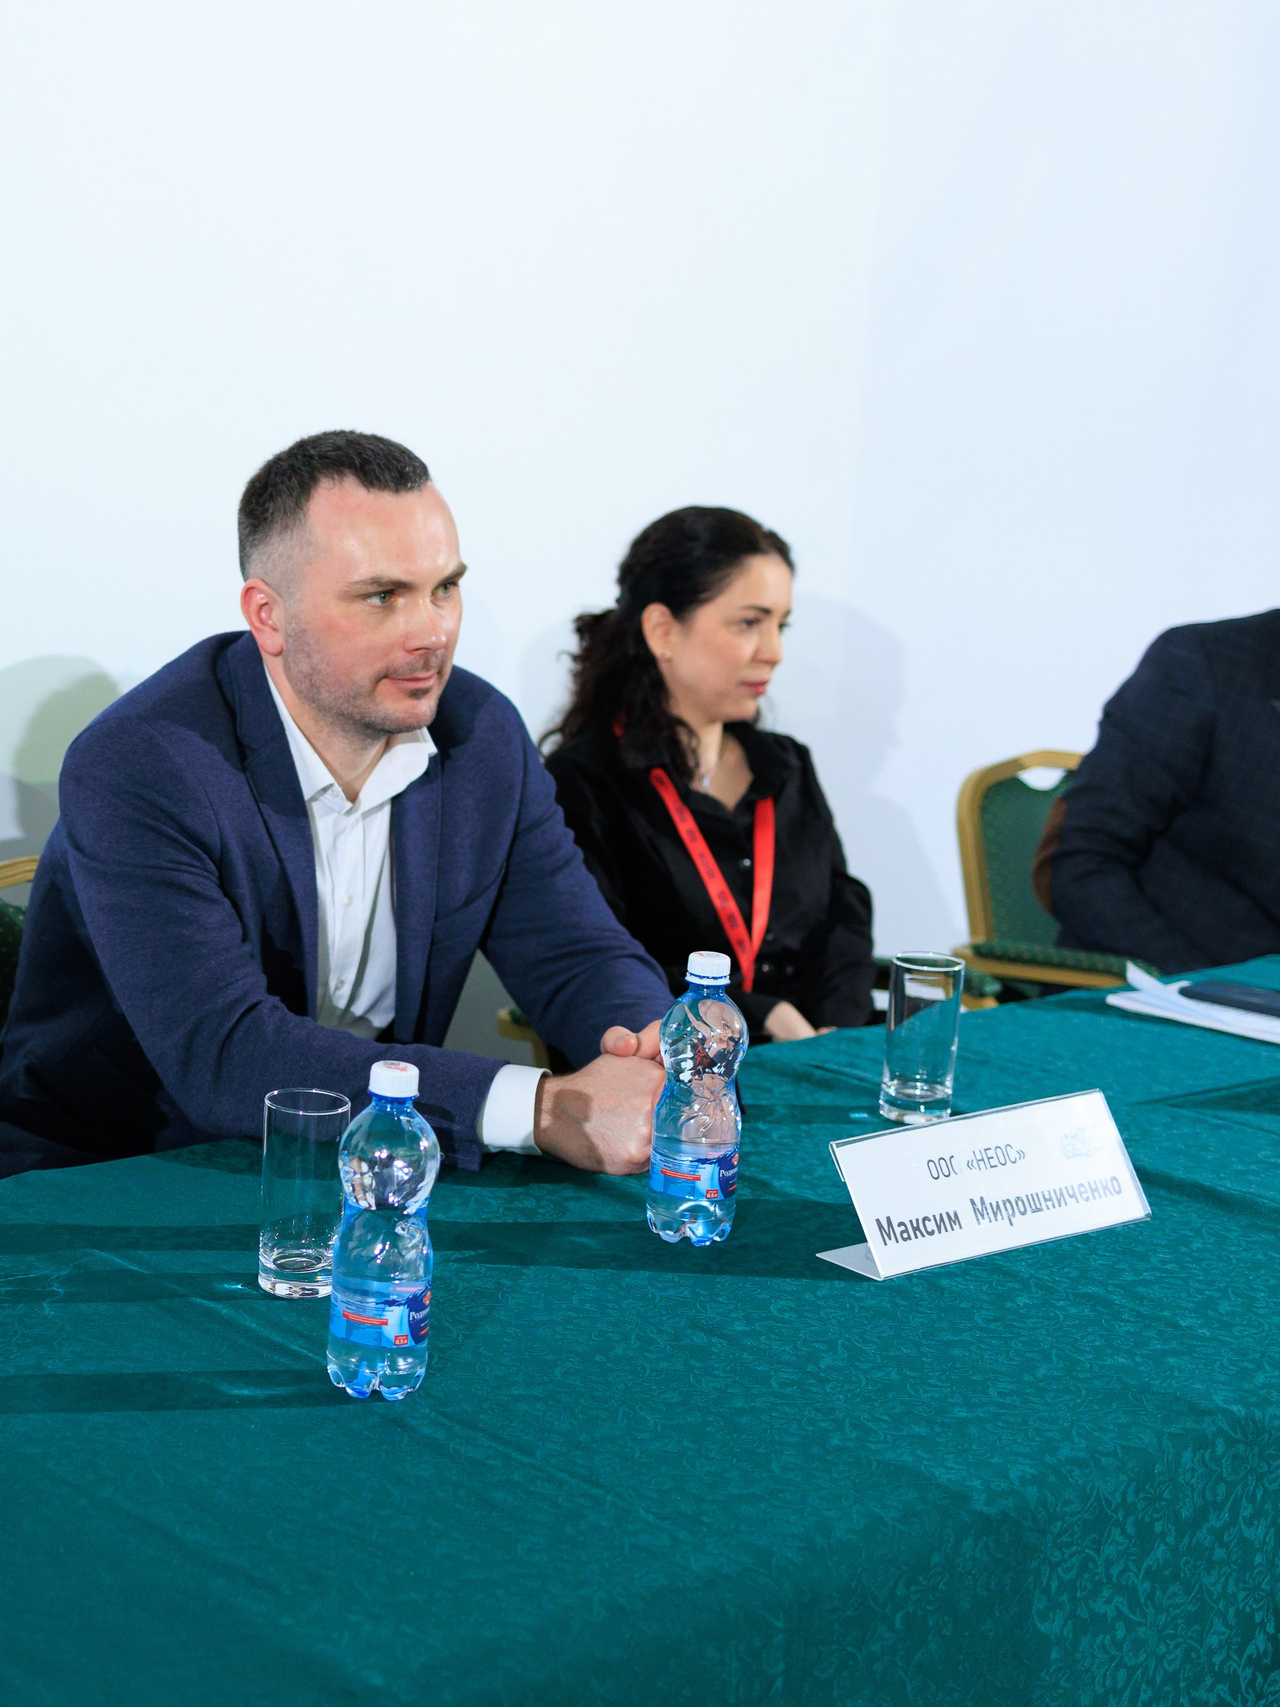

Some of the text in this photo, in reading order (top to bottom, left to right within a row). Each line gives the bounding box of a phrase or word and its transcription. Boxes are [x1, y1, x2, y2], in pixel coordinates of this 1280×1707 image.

[966, 1144, 1026, 1171] «НЕОС»
[875, 1175, 1123, 1246] Максим Мирошниченко
